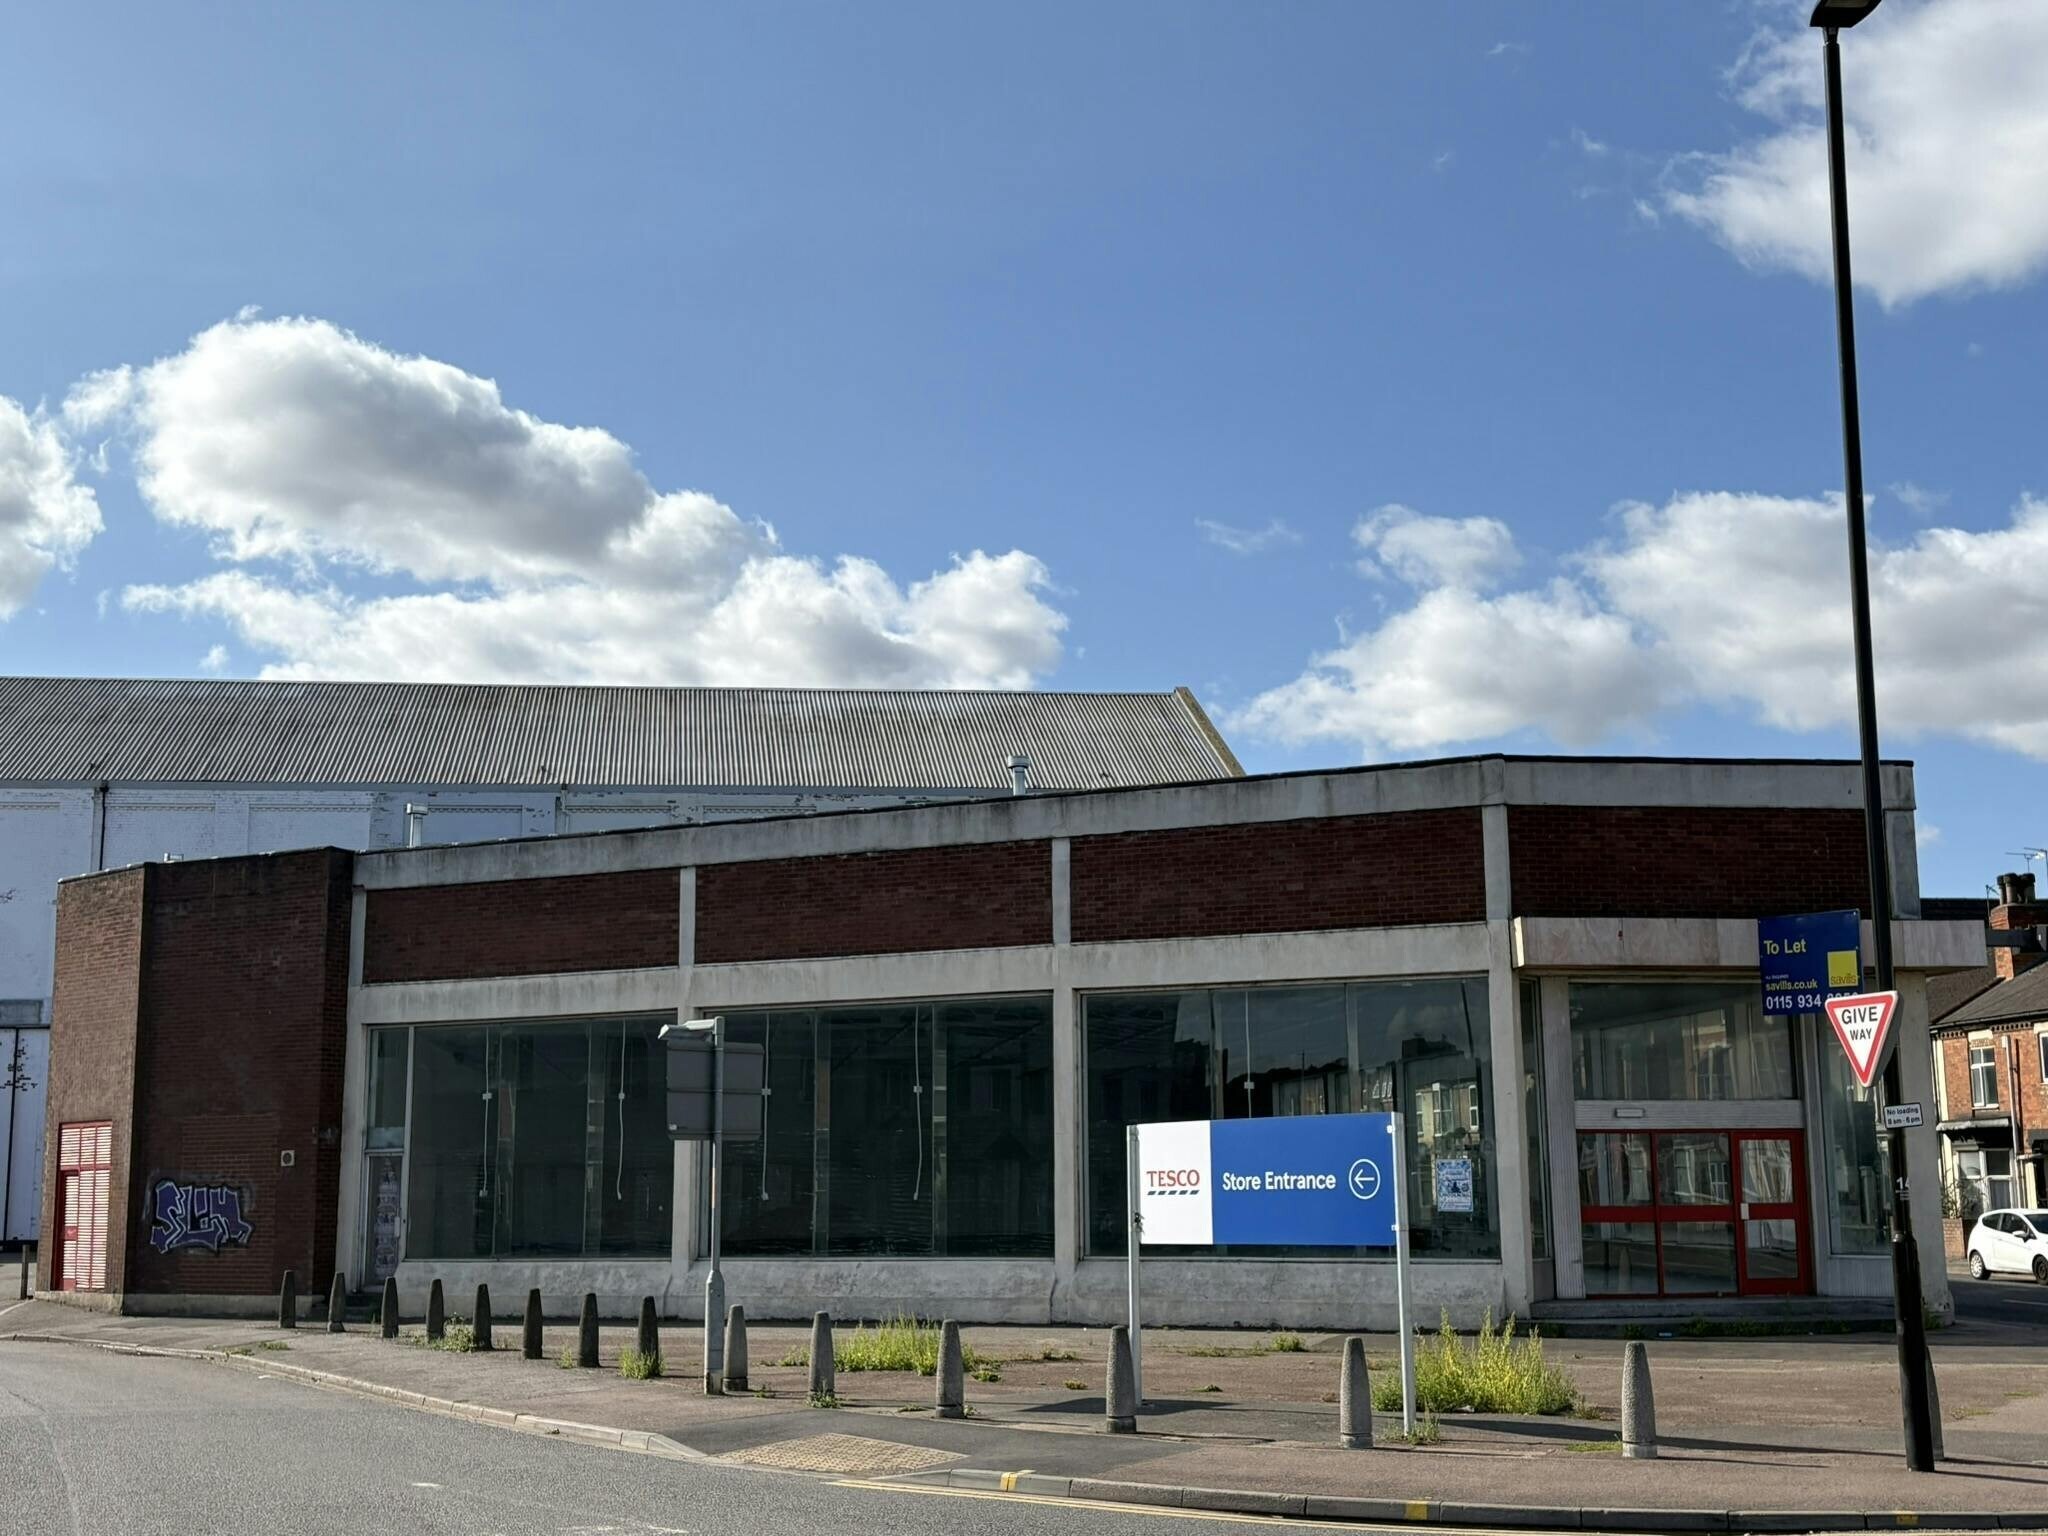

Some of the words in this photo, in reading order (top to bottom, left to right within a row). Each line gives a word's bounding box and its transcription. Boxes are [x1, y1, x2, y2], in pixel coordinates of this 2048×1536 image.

[1763, 940, 1779, 955] To
[1785, 938, 1806, 954] Let
[1766, 978, 1818, 991] savills.co.uk
[1831, 973, 1858, 985] savills
[1766, 995, 1792, 1010] 0115
[1797, 994, 1822, 1008] 934
[1841, 1006, 1878, 1025] GIVE
[1850, 1028, 1872, 1041] WAY
[1896, 1107, 1919, 1115] loading
[1911, 1116, 1920, 1124] pm
[1146, 1169, 1200, 1187] TESCO
[1222, 1172, 1262, 1191] Store
[1264, 1171, 1337, 1190] Entrance
